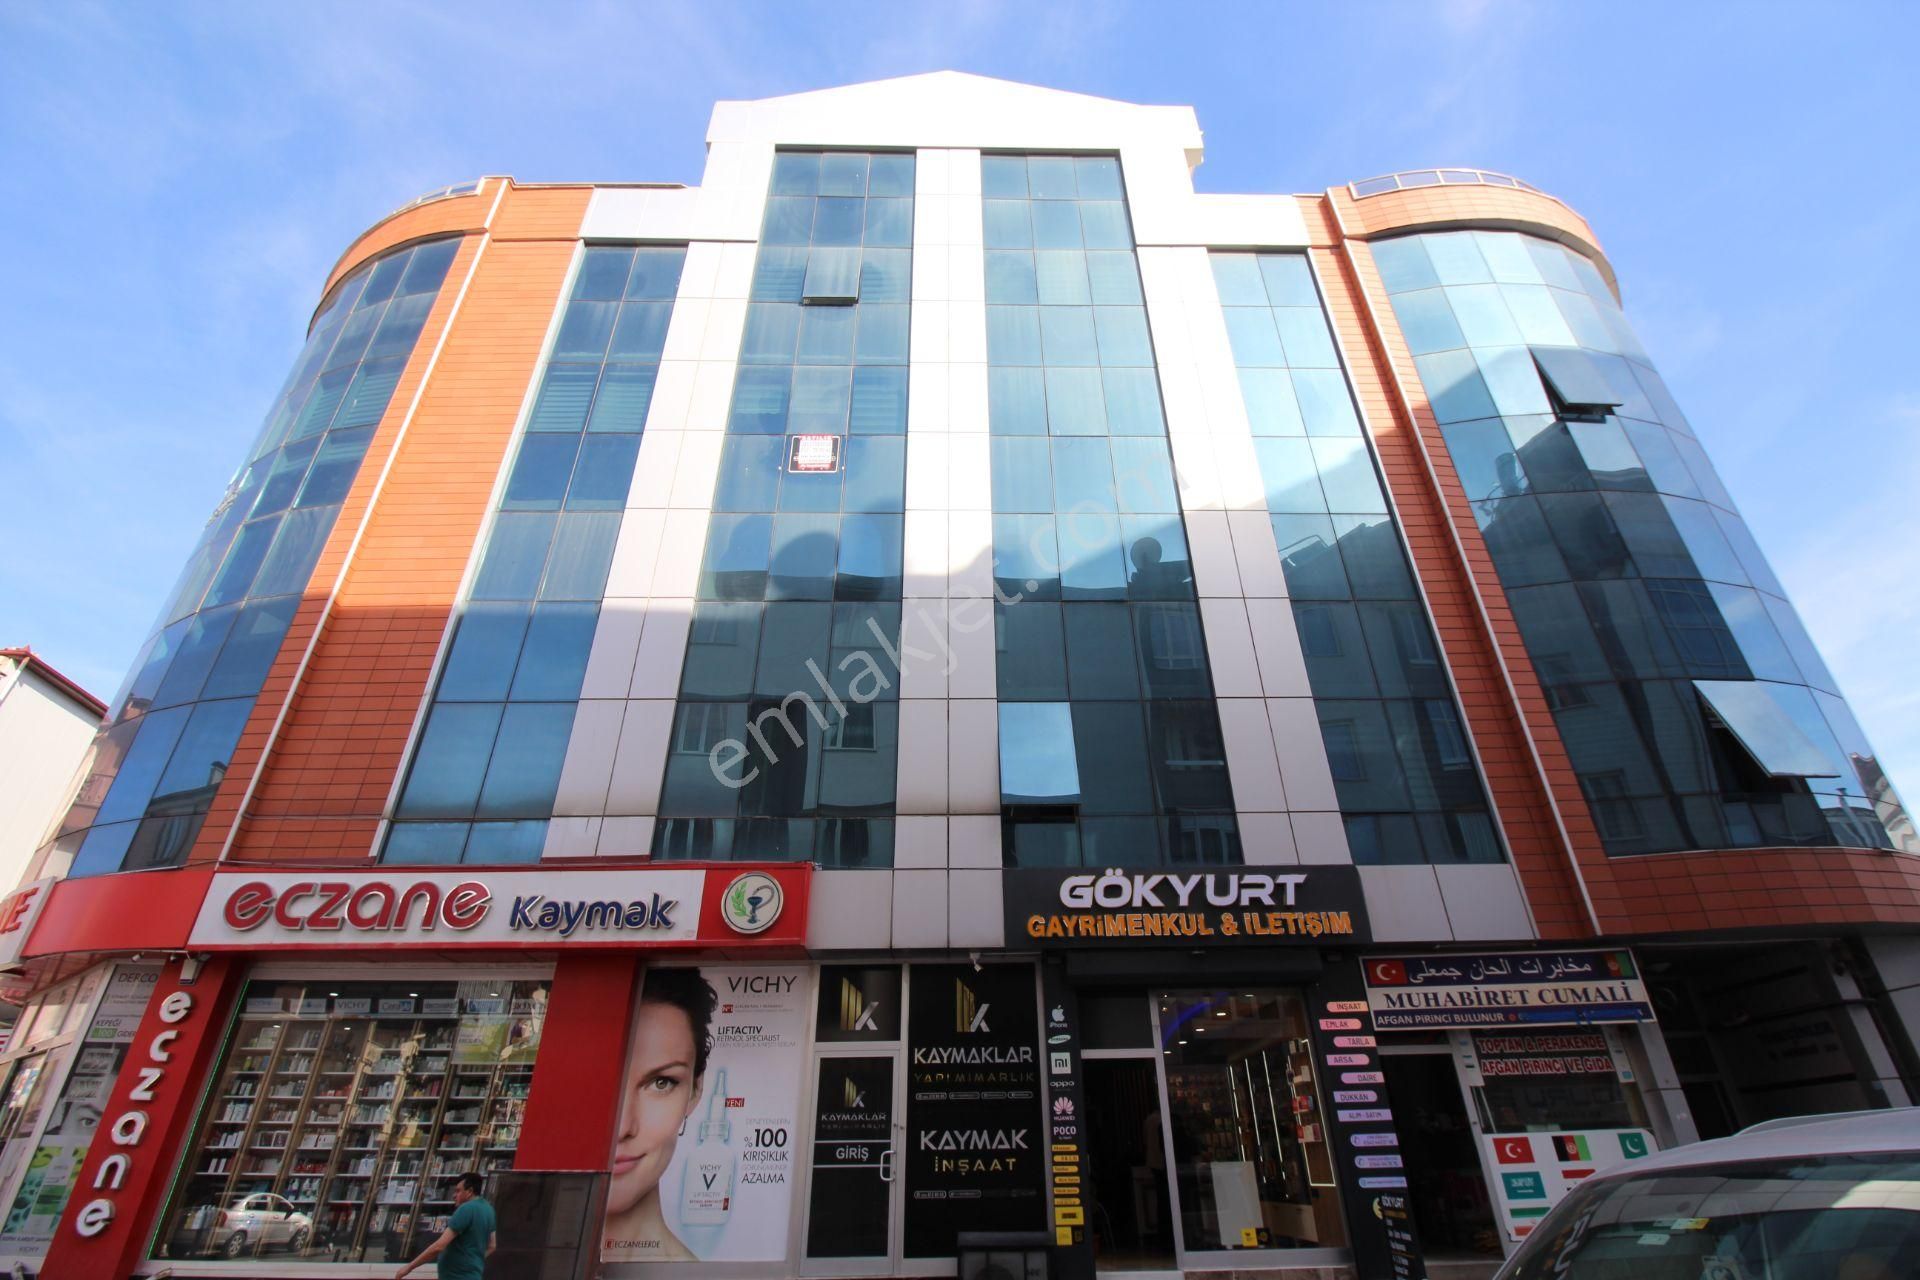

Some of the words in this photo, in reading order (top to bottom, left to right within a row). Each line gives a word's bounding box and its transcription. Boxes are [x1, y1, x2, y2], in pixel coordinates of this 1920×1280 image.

[1059, 868, 1307, 908] GÖKYURT
[223, 881, 492, 931] eczane
[510, 893, 679, 936] Kaymak
[1221, 913, 1240, 935] &
[728, 976, 797, 993] VICHY
[1384, 987, 1530, 1009] MUHABİRET
[1538, 982, 1633, 1004] CUMALİ
[1377, 1015, 1412, 1025] AFGAN
[1455, 1012, 1505, 1022] BULUNUR
[718, 1026, 763, 1034] LIFTACTIV
[1478, 1037, 1523, 1052] TOPTAN
[1537, 1035, 1606, 1050] PERAKENDE
[914, 1046, 1032, 1064] KAYMAKLAR
[1482, 1059, 1521, 1075] AFGAN
[1567, 1058, 1583, 1072] VE
[1585, 1057, 1614, 1071] GIDA
[76, 991, 191, 1236] eczane
[1053, 1126, 1076, 1135] POCO
[920, 1129, 1028, 1151] KAYMAK
[835, 1145, 869, 1162] GİRİŞ
[742, 1173, 785, 1184] AZALMA
